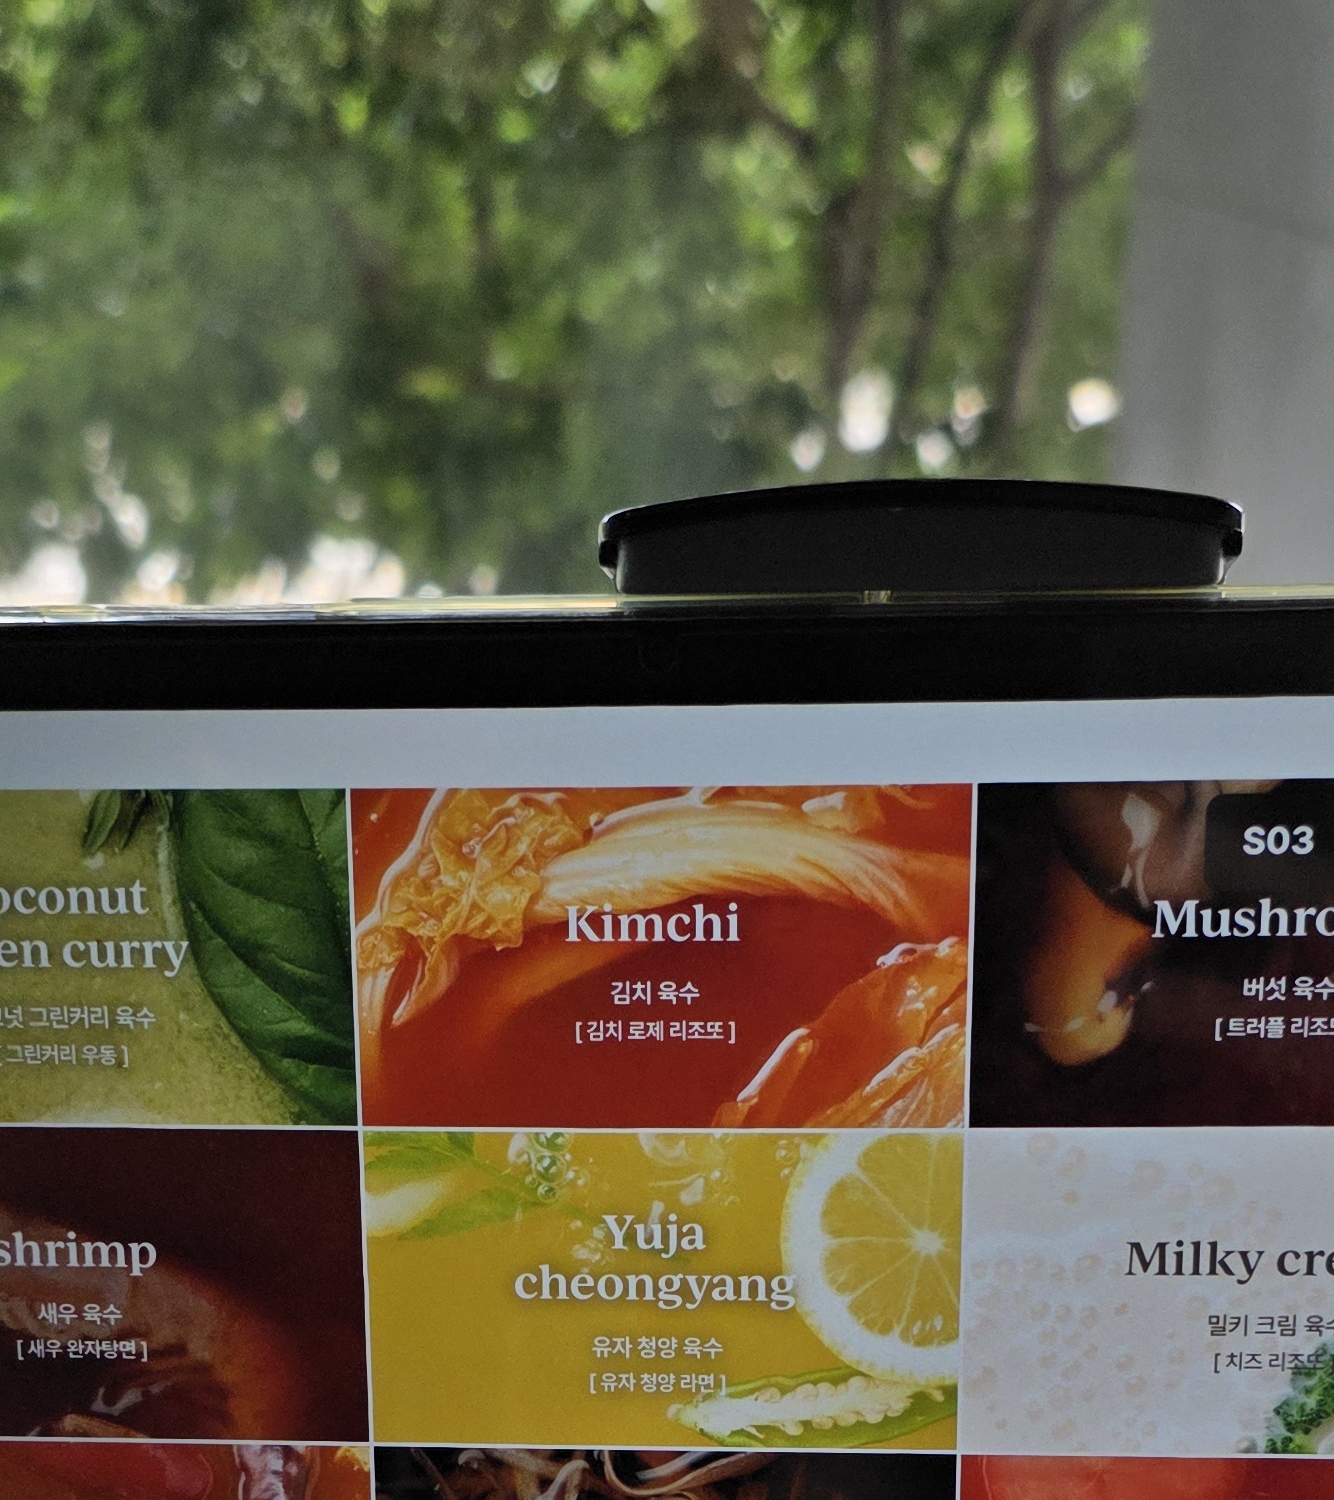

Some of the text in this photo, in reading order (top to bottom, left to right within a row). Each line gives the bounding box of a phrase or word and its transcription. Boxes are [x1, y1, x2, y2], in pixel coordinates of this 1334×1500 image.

[1242, 825, 1314, 855] S03
[564, 902, 740, 942] Kimchi
[62, 938, 188, 977] curry
[610, 980, 700, 1006] 김치 육수
[1242, 976, 1287, 1002] 버섯
[29, 1005, 109, 1030] 그린커리
[115, 1006, 156, 1030] 육수
[627, 1020, 664, 1042] 로제
[602, 1213, 706, 1258] Yuja
[1124, 1240, 1265, 1284] Milky
[514, 1265, 796, 1310] cheongyang
[38, 1302, 123, 1326] 새우 육수
[1208, 1314, 1248, 1337] 밀키
[1255, 1314, 1297, 1337] 크림
[592, 1336, 723, 1360] 유자 청양 육수
[640, 1373, 676, 1394] 청양
